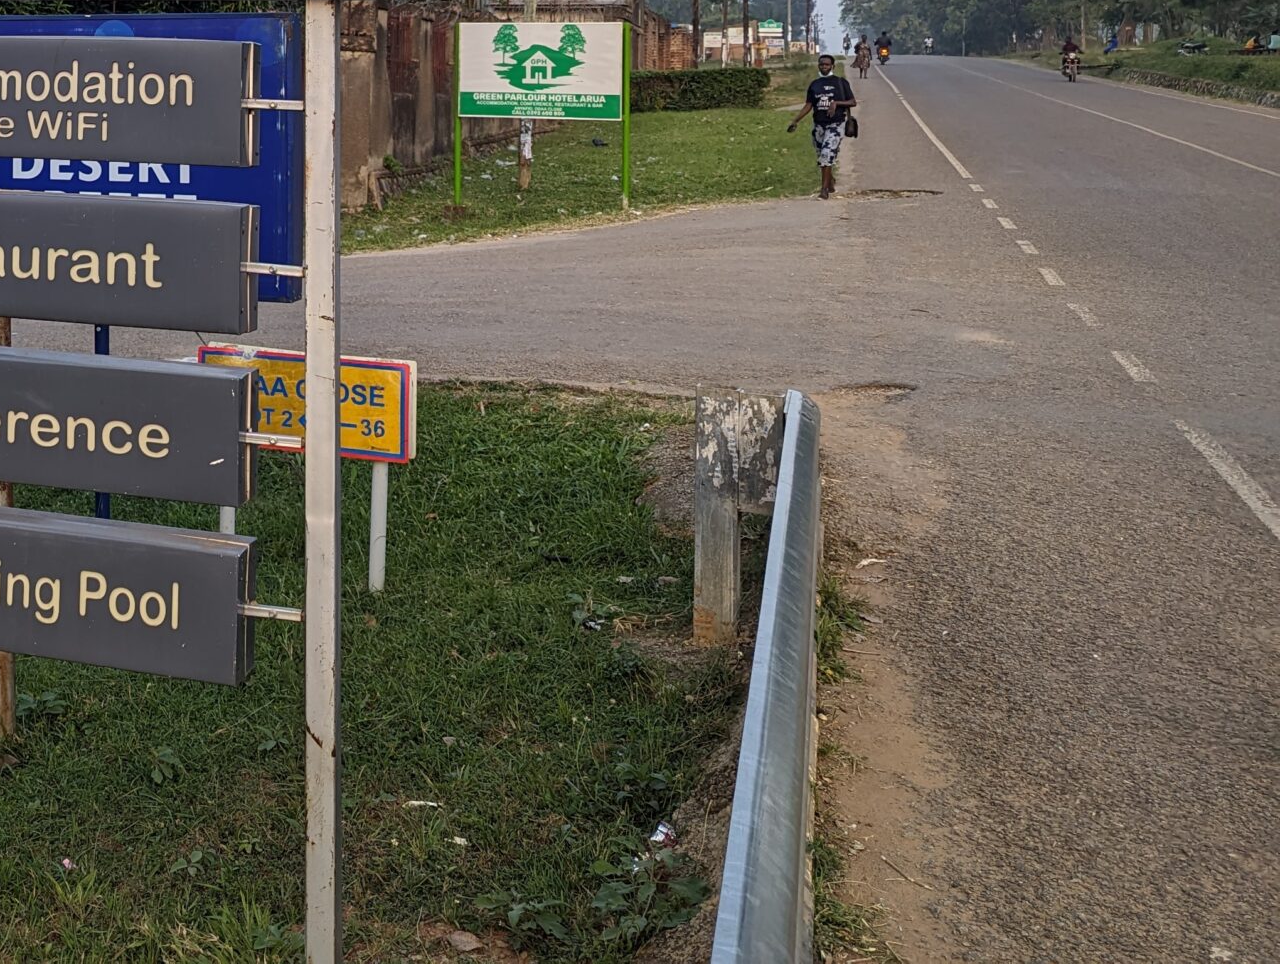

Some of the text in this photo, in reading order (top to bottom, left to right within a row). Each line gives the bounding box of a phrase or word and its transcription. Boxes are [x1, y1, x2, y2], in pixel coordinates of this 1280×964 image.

[504, 93, 547, 102] PARLOUR
[548, 94, 578, 102] HOTEL
[579, 95, 606, 103] ARUA
[27, 109, 109, 142] WiFi
[296, 379, 385, 407] COSE
[281, 410, 293, 427] 2
[361, 419, 385, 438] 36
[79, 569, 179, 630] Pool
